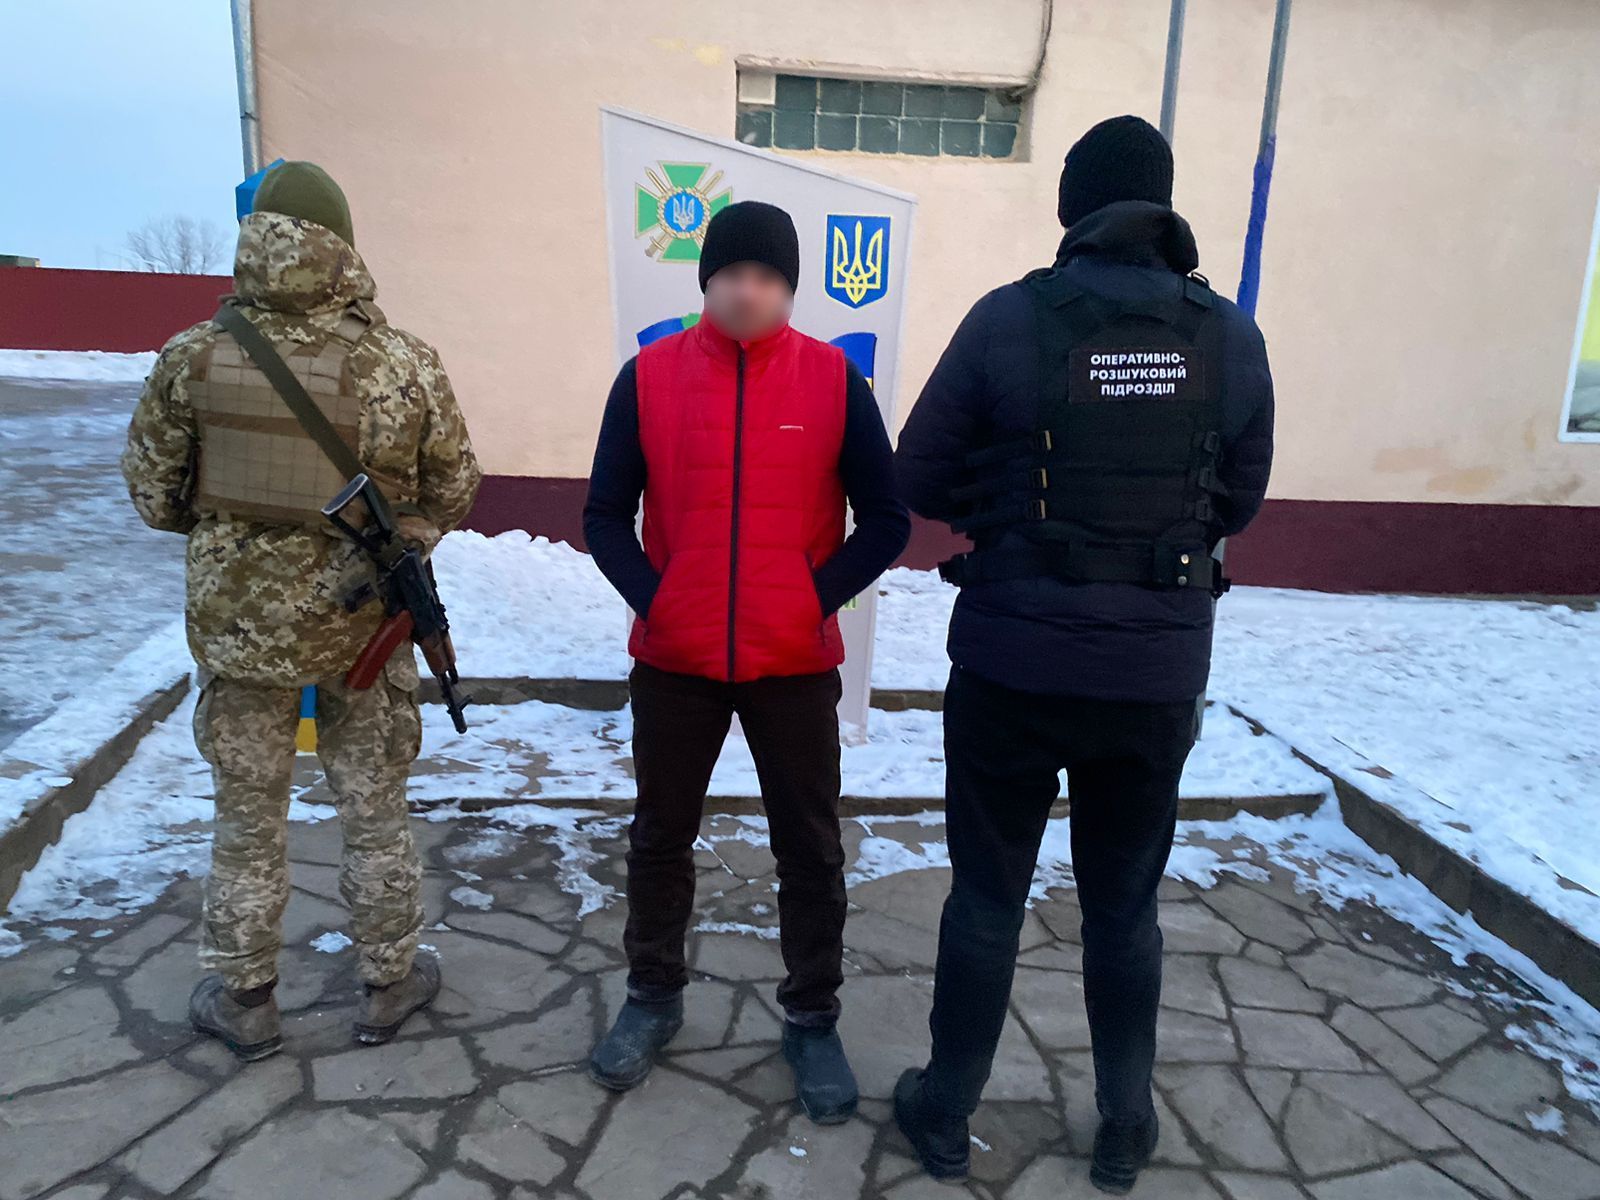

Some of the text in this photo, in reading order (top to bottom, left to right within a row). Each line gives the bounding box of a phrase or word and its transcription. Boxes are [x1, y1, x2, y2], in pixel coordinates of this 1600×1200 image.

[1090, 353, 1185, 365] ОПЕРАТИВНО-
[1090, 365, 1186, 380] РОЗШУКОВИЙ
[1101, 383, 1175, 396] ПІДРОЗДІЛ
